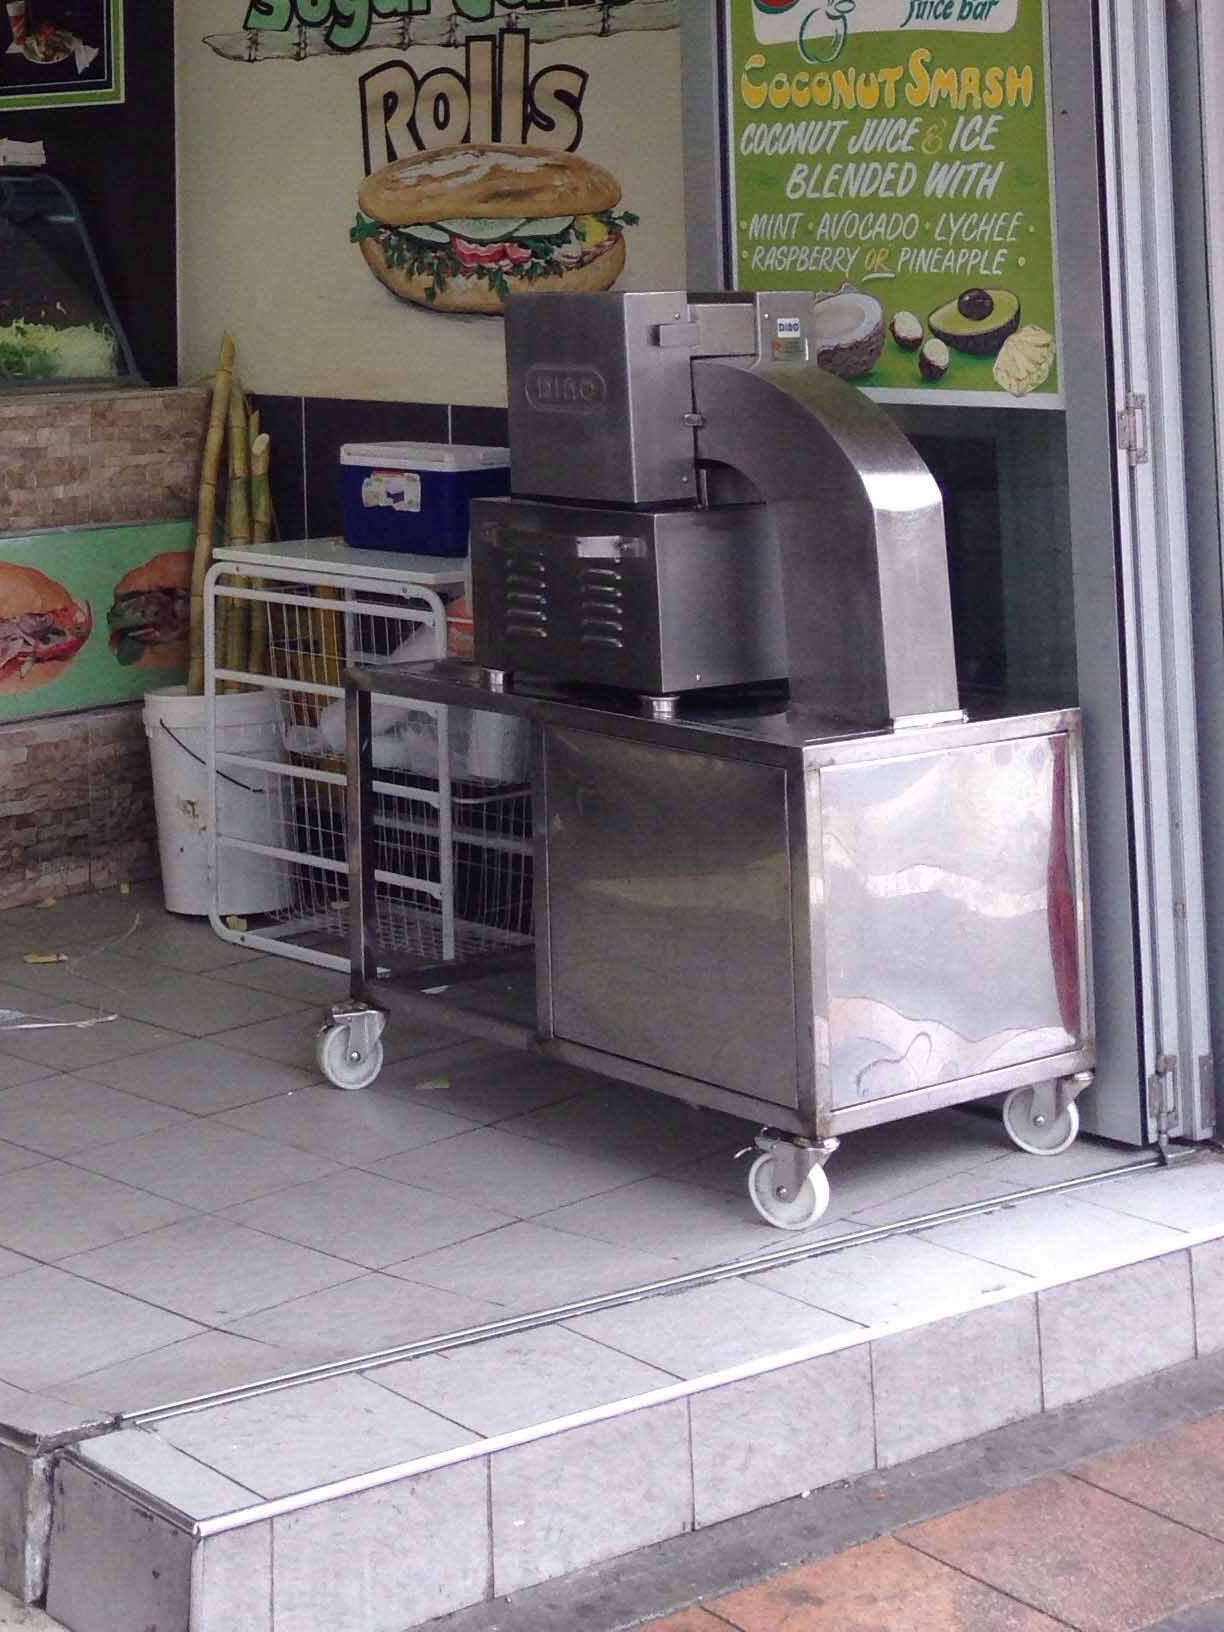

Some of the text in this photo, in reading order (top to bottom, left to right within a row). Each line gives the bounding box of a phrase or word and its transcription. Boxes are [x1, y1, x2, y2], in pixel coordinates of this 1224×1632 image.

[741, 47, 1034, 111] COCONUT SMASH
[358, 28, 590, 178] Rolls
[740, 120, 849, 156] COCONUT
[847, 117, 923, 155] JUICE
[948, 114, 1005, 152] ICE
[785, 161, 1005, 200] BLENDED WITH
[748, 210, 1025, 245] MINT AVOCADO LYCHEE
[751, 246, 1009, 276] RASPBERRY OR PINEAPPLE
